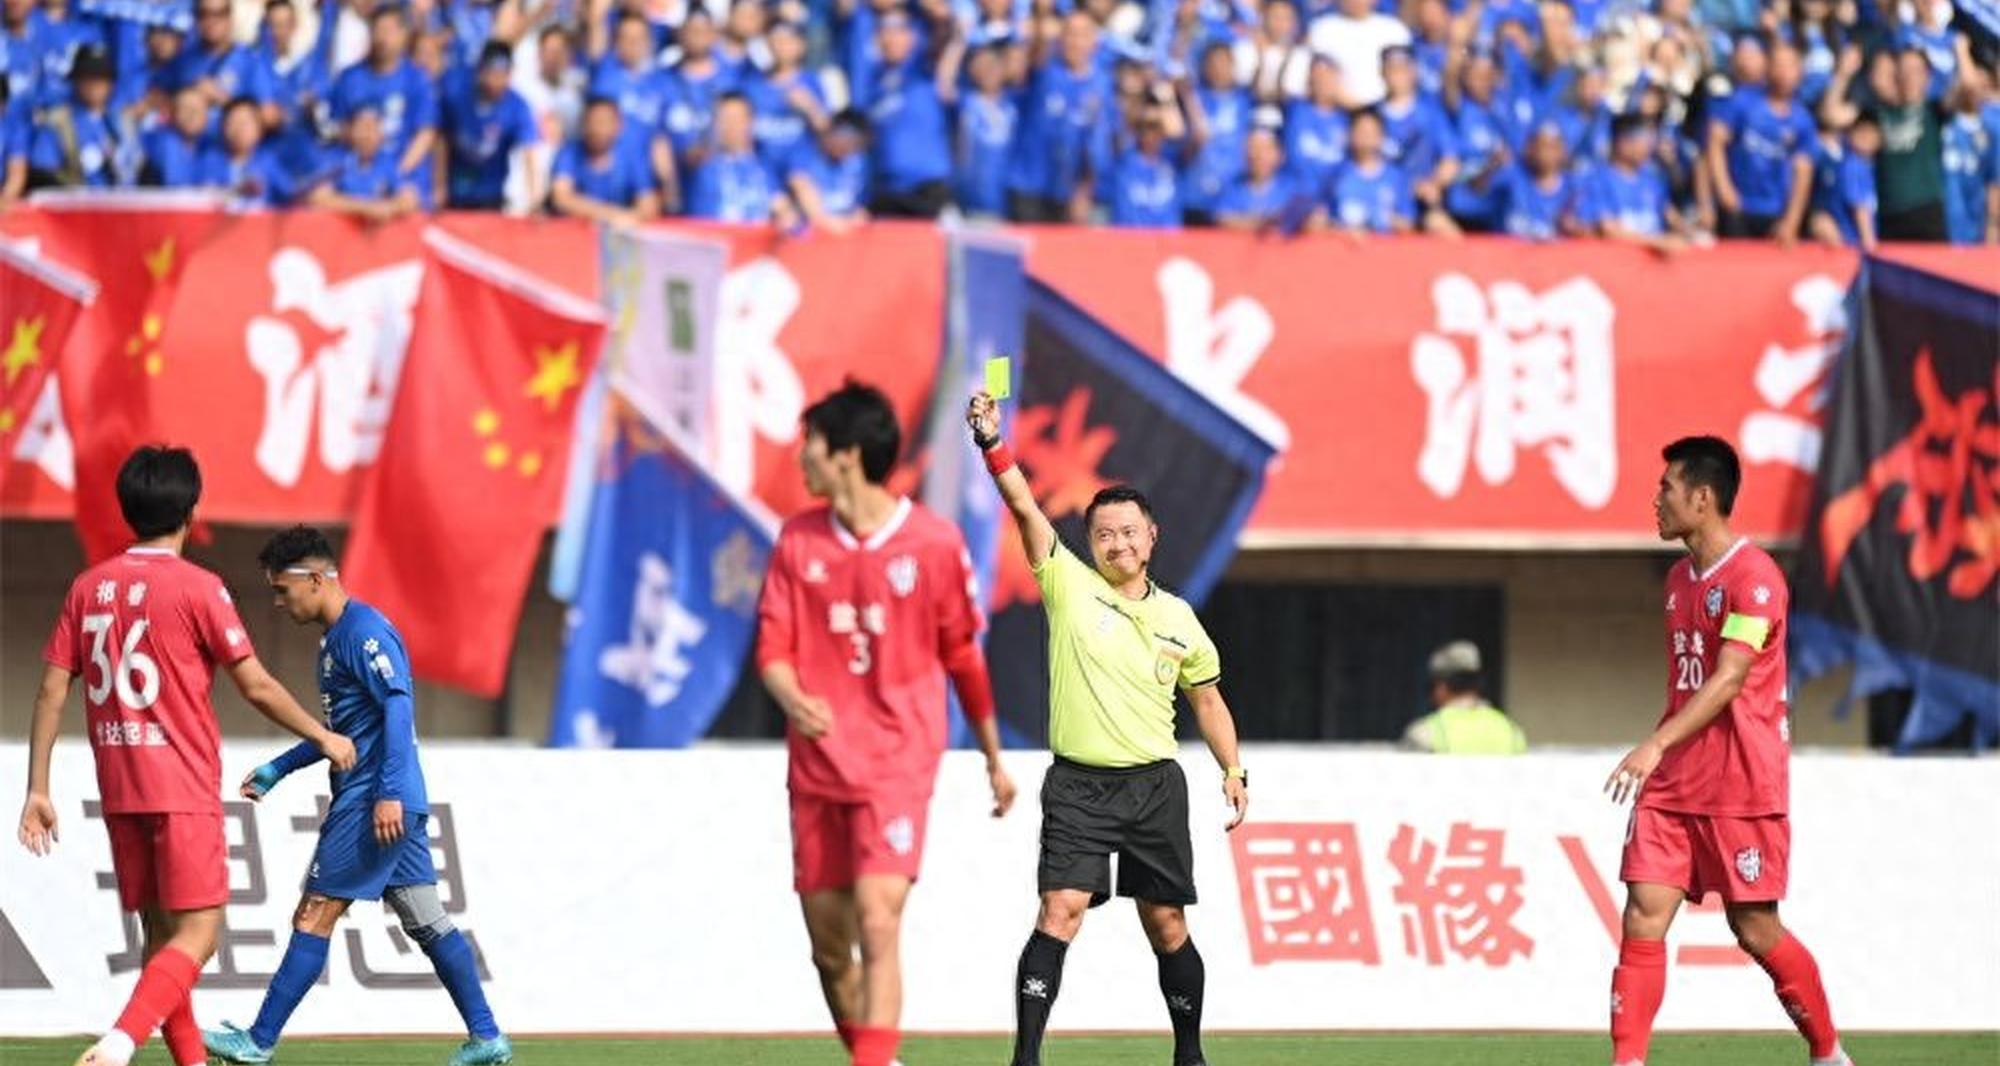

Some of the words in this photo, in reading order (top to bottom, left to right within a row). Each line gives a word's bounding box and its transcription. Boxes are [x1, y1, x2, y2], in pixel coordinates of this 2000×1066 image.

[82, 614, 160, 711] 36
[848, 632, 872, 676] 3
[1676, 656, 1704, 691] 20
[1229, 821, 1536, 968] 國緣
